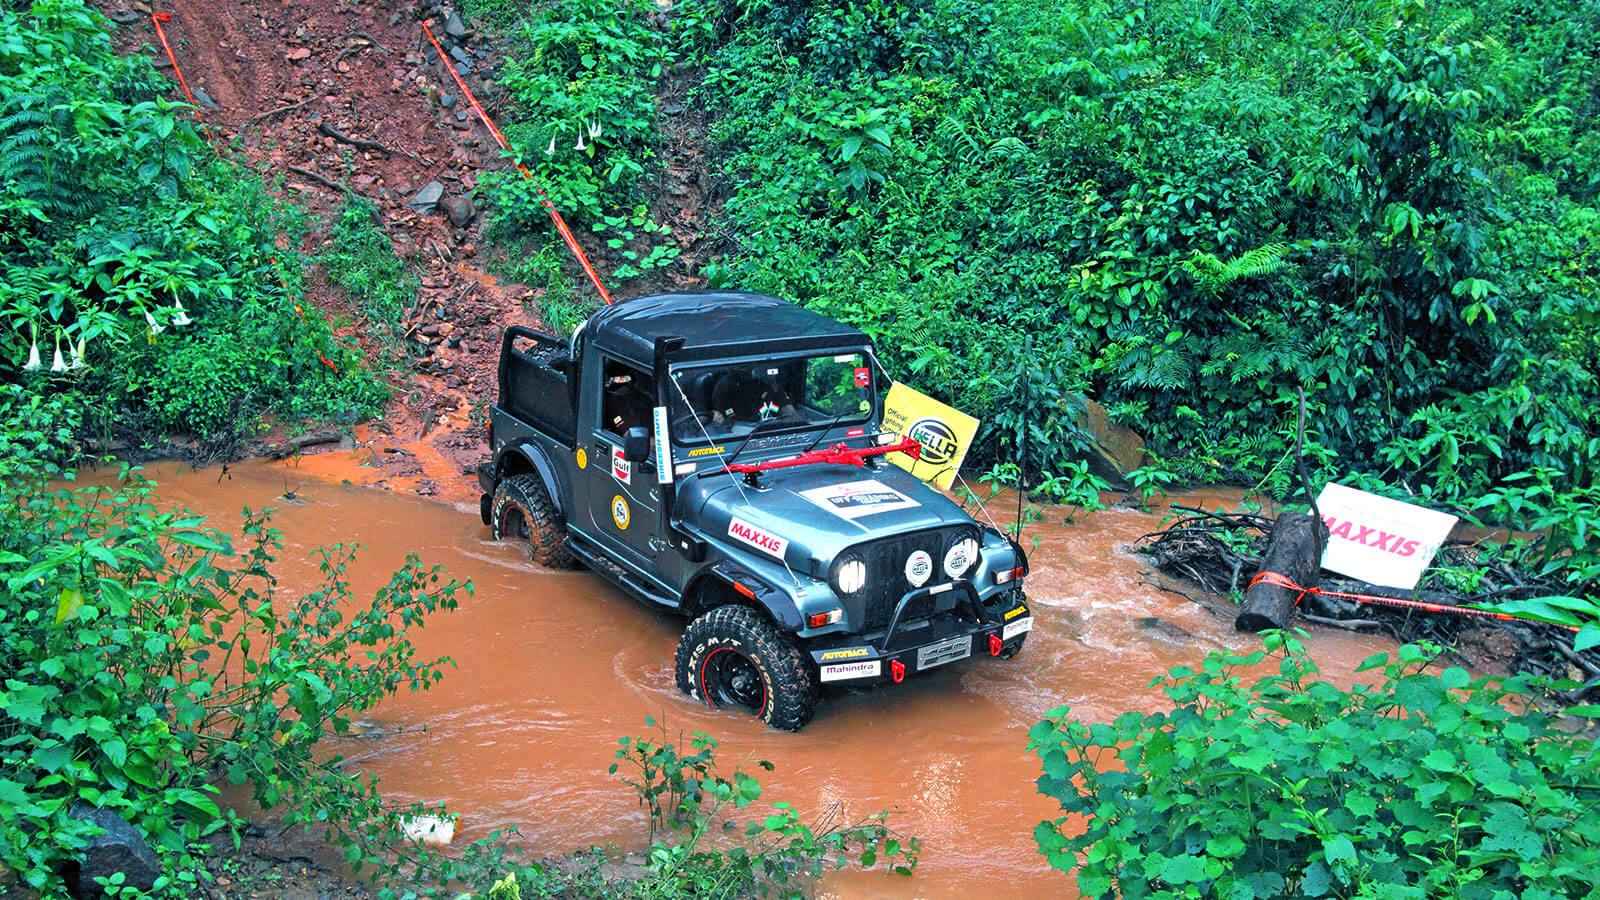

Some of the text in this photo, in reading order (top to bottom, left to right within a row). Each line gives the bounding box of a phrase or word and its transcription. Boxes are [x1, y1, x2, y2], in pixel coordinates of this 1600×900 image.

[887, 408, 908, 422] Official
[884, 416, 904, 431] ighting
[913, 428, 958, 458] HELLA
[613, 457, 629, 472] Gulf
[687, 637, 742, 700] AXXIS M/T
[827, 664, 874, 674] Mahindra
[750, 653, 775, 724] BIGHOR
